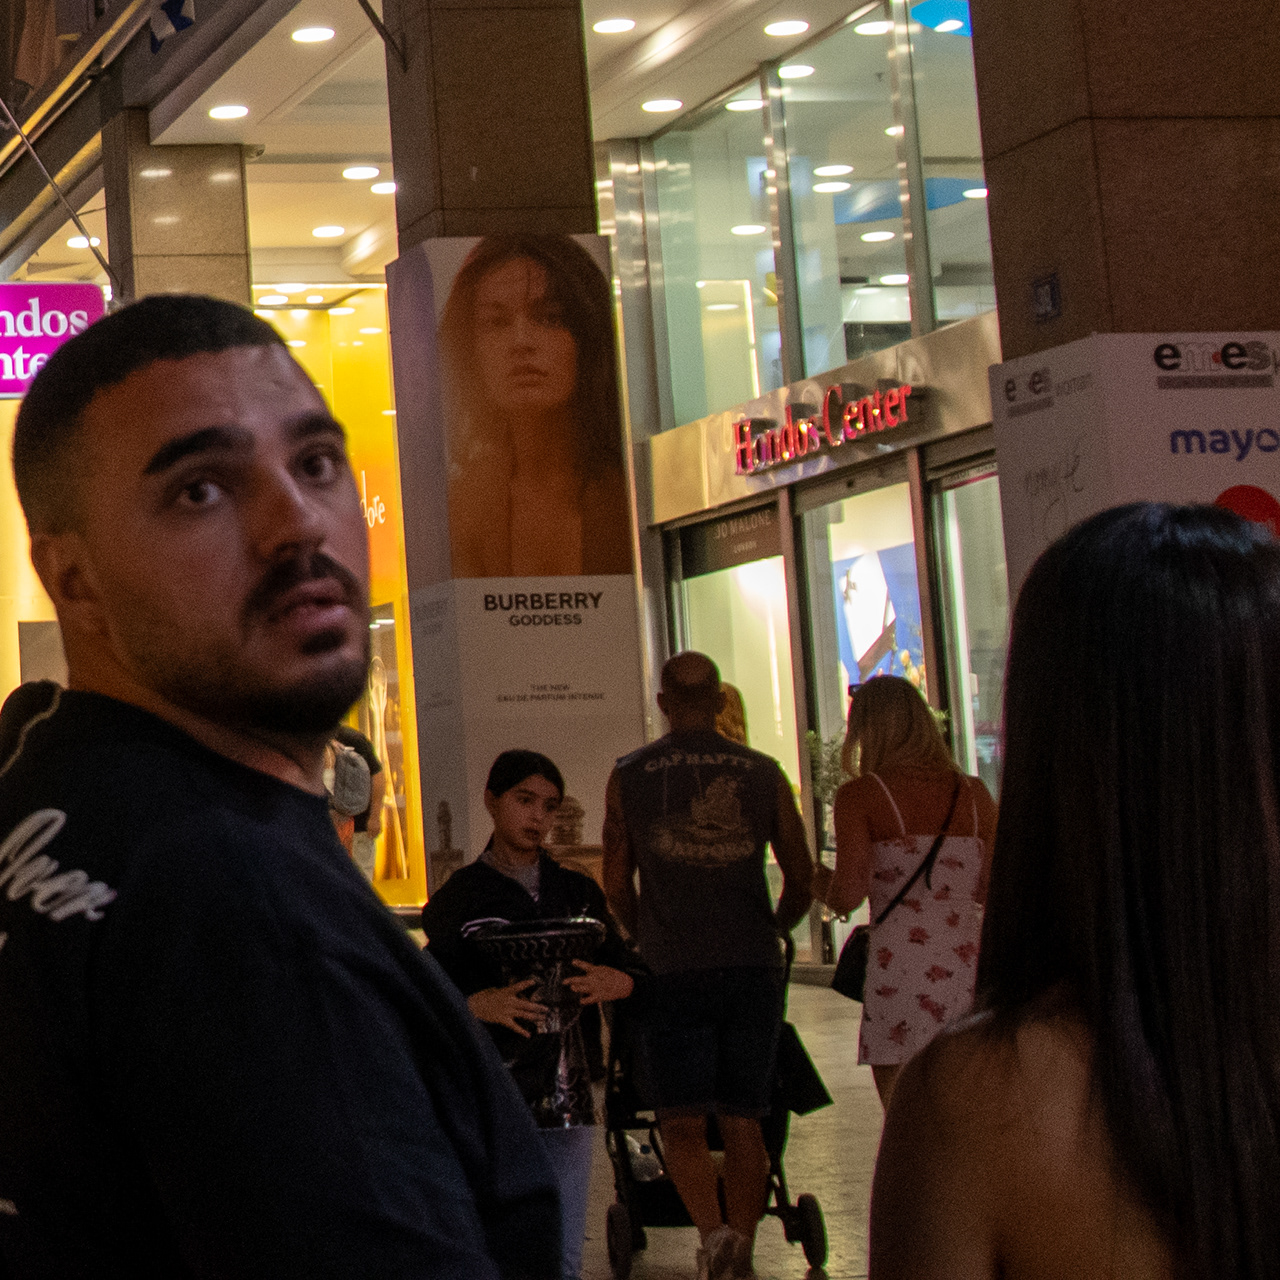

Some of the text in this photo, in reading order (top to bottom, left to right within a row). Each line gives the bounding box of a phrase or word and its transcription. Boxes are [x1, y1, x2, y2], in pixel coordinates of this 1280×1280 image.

[733, 385, 912, 475] Hondos Center
[484, 592, 604, 611] BURBERRY
[509, 613, 582, 626] GODDESS
